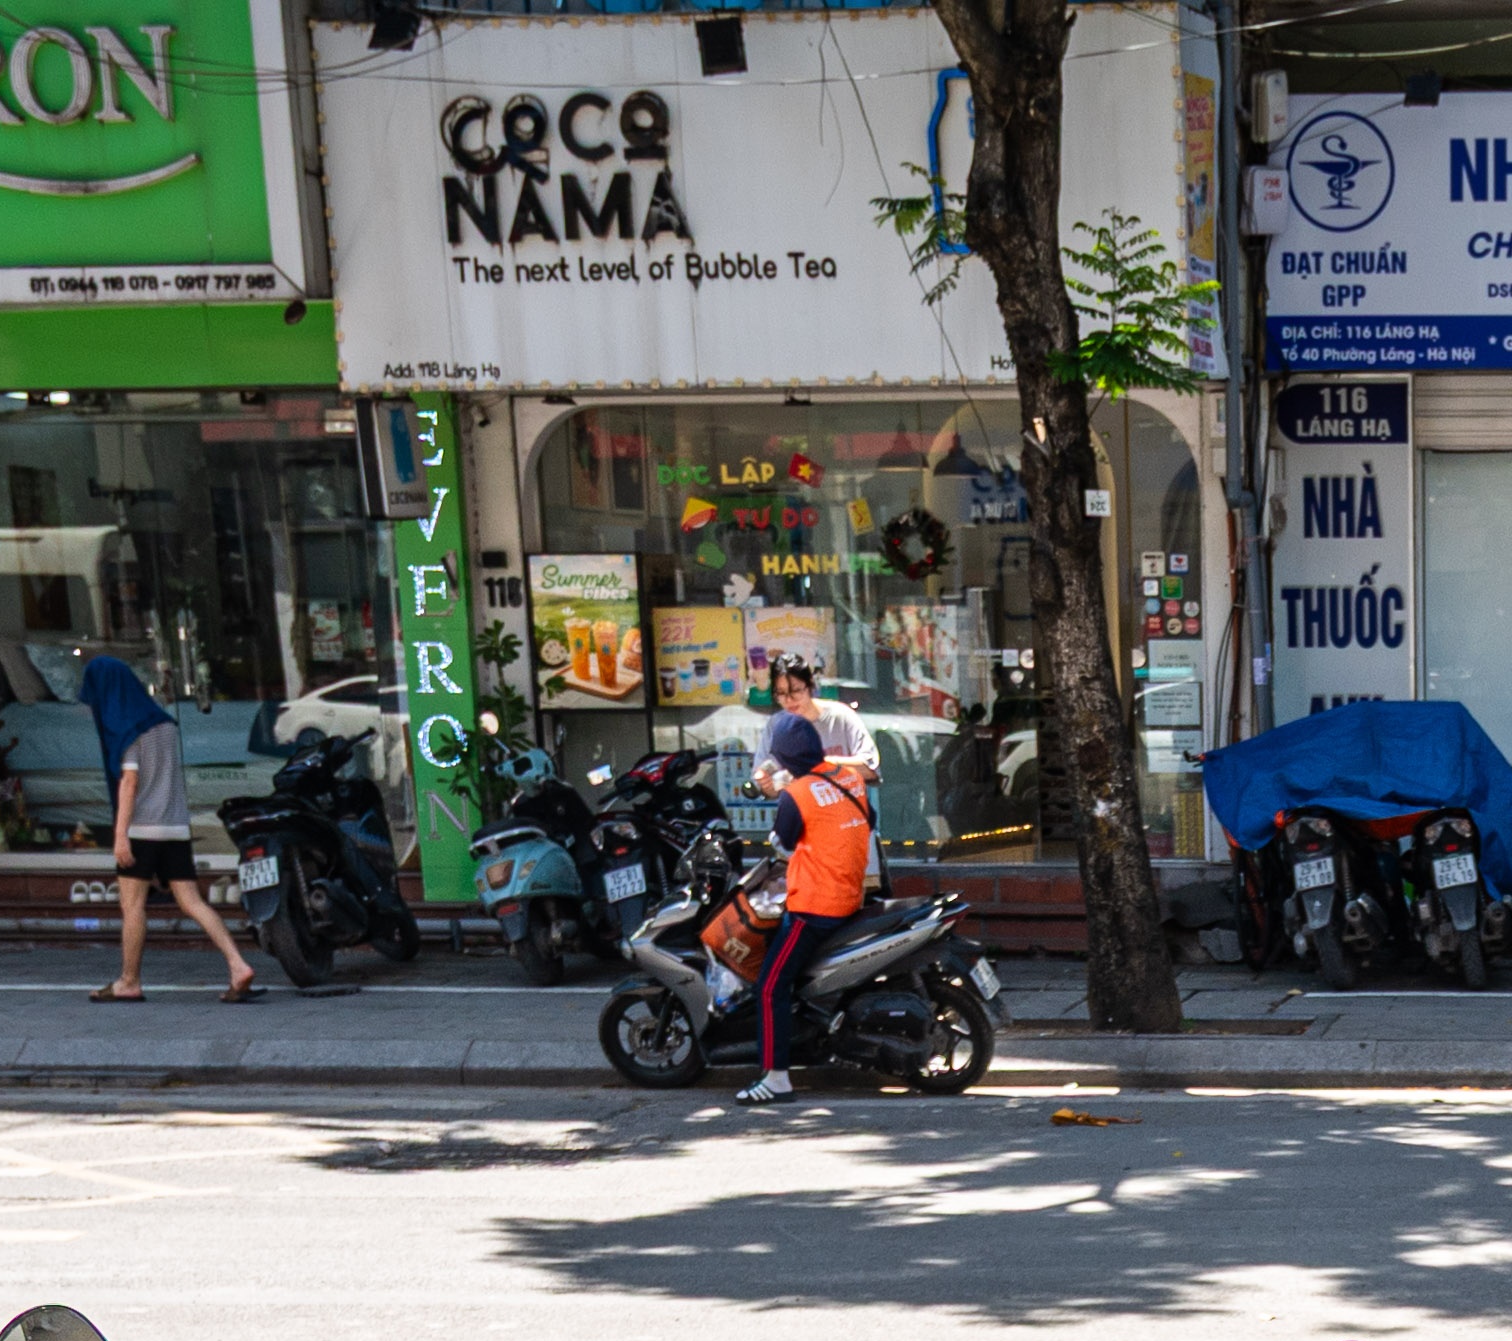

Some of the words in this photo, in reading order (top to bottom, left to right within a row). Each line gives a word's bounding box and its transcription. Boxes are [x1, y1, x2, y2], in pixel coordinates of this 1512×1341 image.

[441, 170, 694, 246] NAMA
[453, 256, 505, 284] The
[514, 256, 571, 284] next
[578, 254, 639, 283] level
[649, 253, 676, 281] of
[687, 252, 778, 282] Bubble
[786, 251, 838, 280] Tea
[1281, 251, 1324, 279] ĐẠT
[1330, 242, 1408, 276] CHUẨN
[1322, 284, 1367, 309] GPP
[1281, 325, 1308, 343] ĐỊA
[1345, 325, 1373, 340] 116
[1375, 322, 1416, 340] LÁNG
[1418, 325, 1441, 343] HẠ
[1302, 347, 1319, 361] 40
[1323, 346, 1377, 366] Phường
[1380, 346, 1416, 365] Láng
[1427, 346, 1447, 361] Hà
[1451, 346, 1476, 365] Nội
[1318, 386, 1368, 414] 116
[1296, 415, 1355, 438] LÁNG
[1361, 418, 1392, 441] HẠ
[719, 456, 776, 488] LẬP
[1302, 461, 1384, 539] NHÀ
[781, 508, 820, 528] DO
[541, 564, 623, 590] Summer
[761, 554, 841, 579] HẠNH
[483, 576, 524, 608] 118
[1281, 563, 1406, 649] THUỐC
